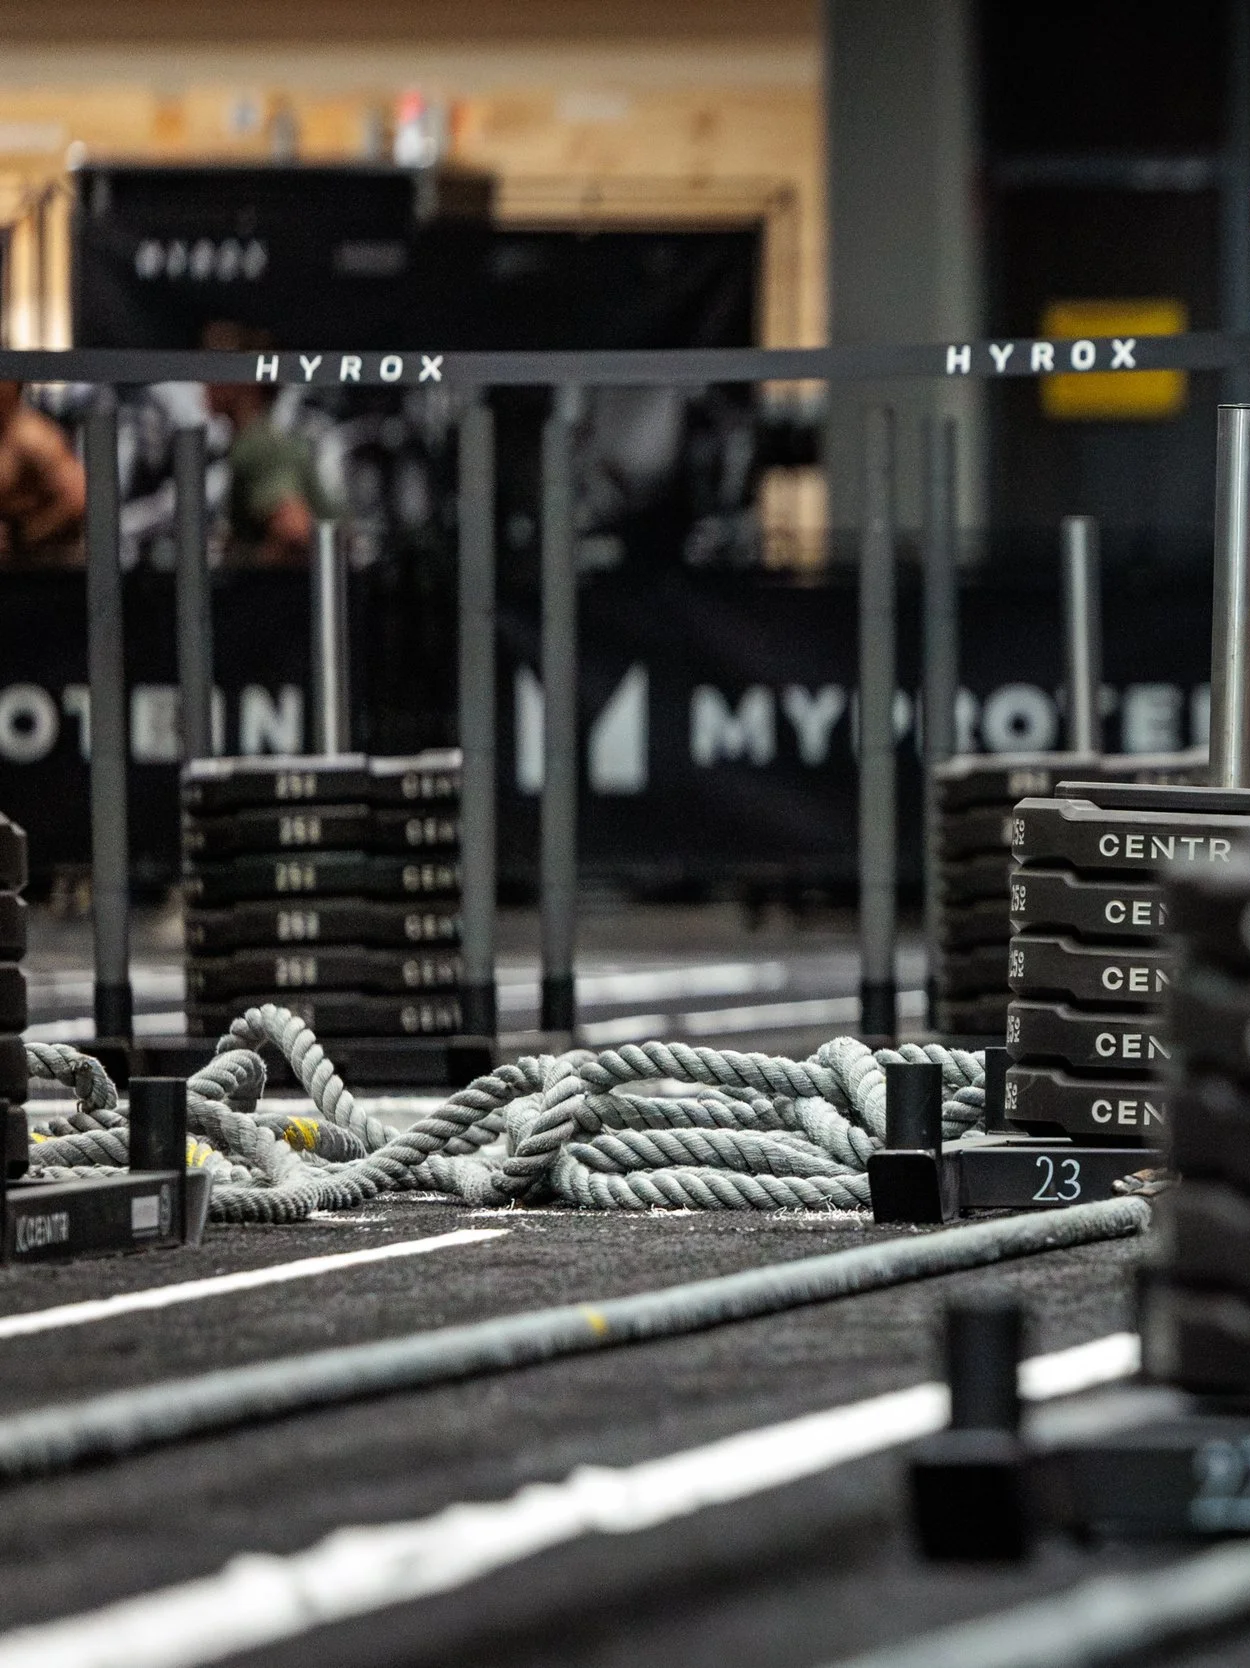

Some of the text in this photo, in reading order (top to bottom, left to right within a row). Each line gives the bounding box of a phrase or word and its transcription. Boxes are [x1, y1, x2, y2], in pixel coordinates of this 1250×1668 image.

[256, 355, 442, 382] HYROX
[946, 338, 1136, 374] HYROX
[1099, 833, 1231, 863] CENTR
[1032, 1155, 1082, 1201] 23
